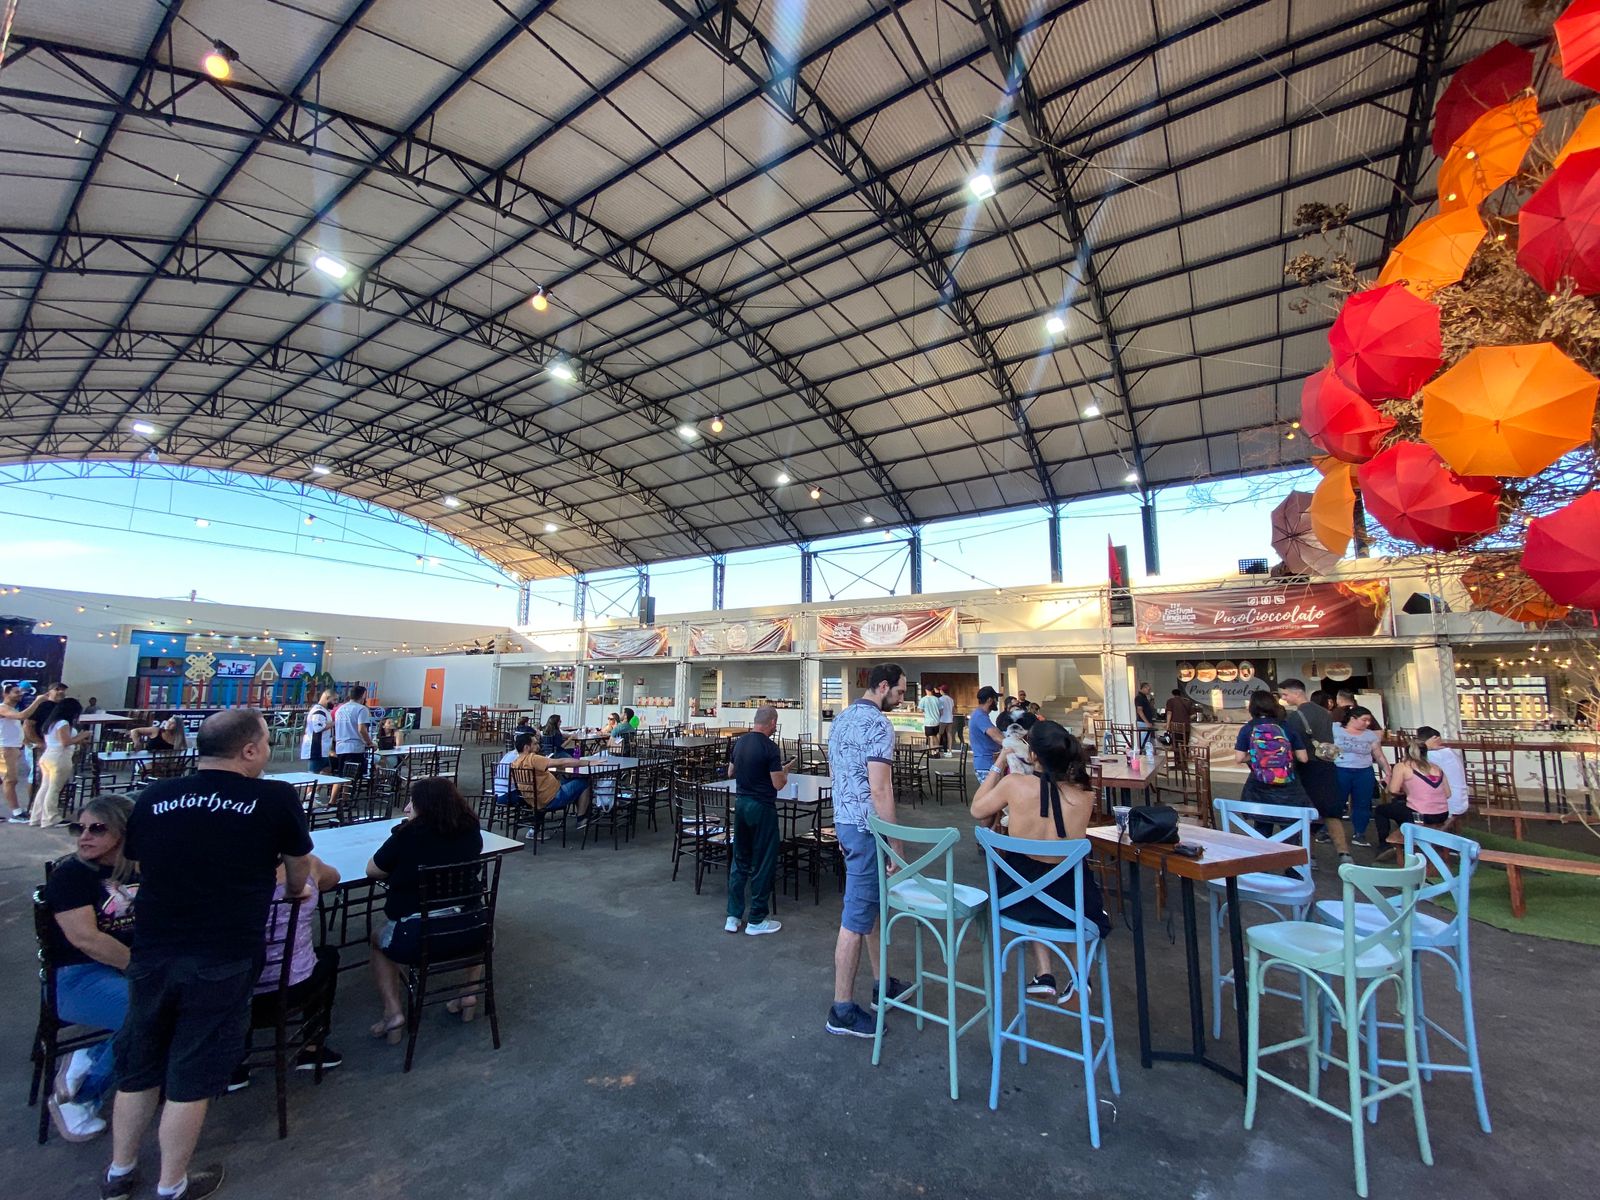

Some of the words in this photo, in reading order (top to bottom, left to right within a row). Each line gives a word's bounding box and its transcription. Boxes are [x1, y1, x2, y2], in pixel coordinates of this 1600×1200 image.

[1164, 607, 1193, 615] Festival
[1213, 605, 1326, 625] PuroCioccolato
[1162, 614, 1196, 622] Linguiça
